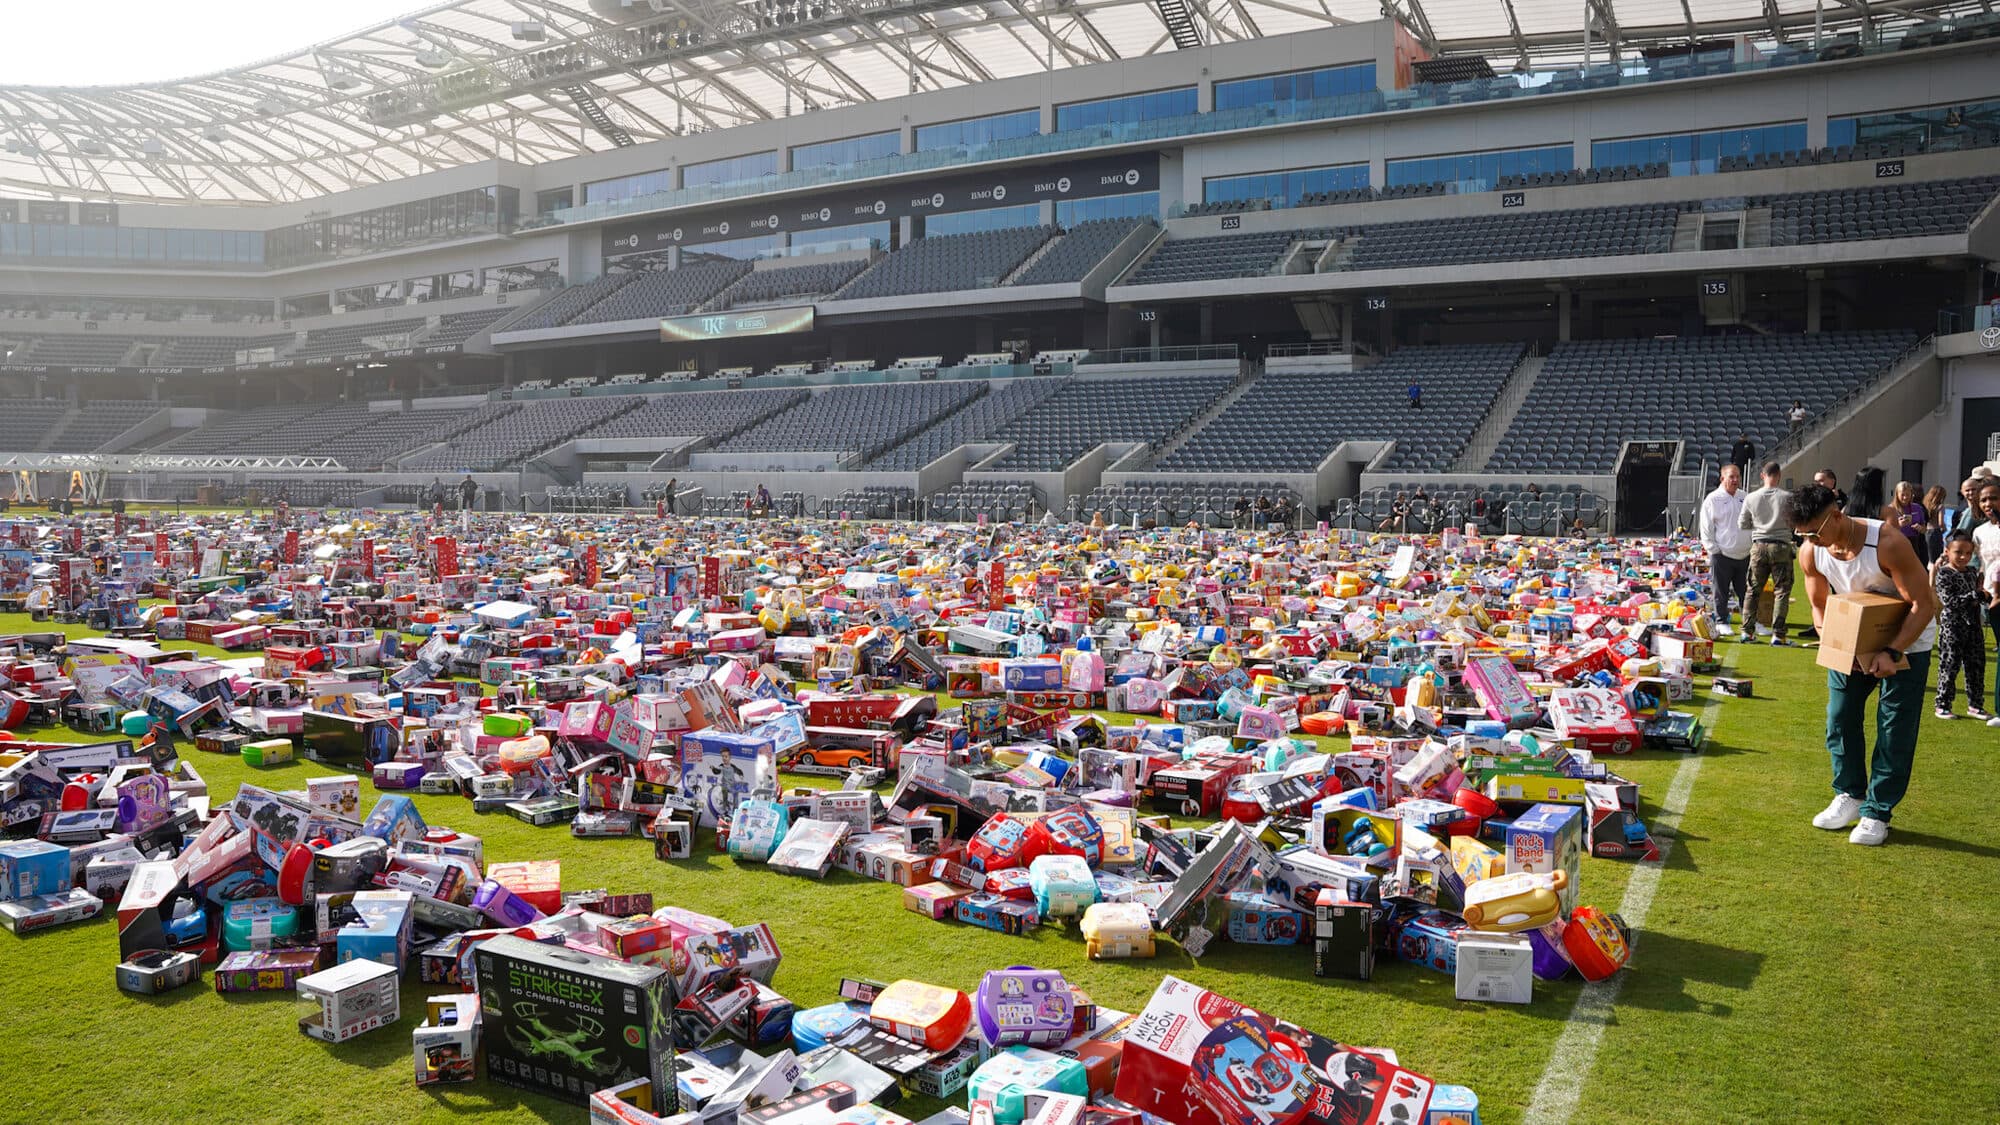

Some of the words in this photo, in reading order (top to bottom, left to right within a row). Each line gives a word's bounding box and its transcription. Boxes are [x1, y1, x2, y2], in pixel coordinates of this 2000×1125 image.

[1879, 164, 1902, 176] 235
[1100, 175, 1123, 185] BMO
[1034, 182, 1055, 193] BMO
[970, 190, 991, 201] BMO
[911, 198, 930, 208] BMO
[1504, 196, 1523, 207] 234
[854, 205, 873, 215] BMO
[801, 212, 818, 222] BMO
[750, 219, 767, 228] BMO
[1223, 219, 1239, 229] 233
[702, 225, 718, 235] BMO
[657, 232, 672, 241] BMO
[614, 239, 629, 247] BMO
[1704, 283, 1726, 295] 135
[1367, 299, 1386, 310] 134
[1139, 311, 1156, 321] 133
[833, 706, 873, 714] MIKE
[823, 715, 883, 724] TYSON
[1514, 833, 1544, 847] Kid's
[1516, 847, 1544, 858] Band
[538, 968, 549, 977] IN
[552, 972, 572, 982] THE
[575, 977, 604, 989] DARK
[510, 970, 604, 1007] STRIKER-X
[510, 988, 523, 996] HD
[525, 990, 566, 1006] CAMERA
[569, 1001, 605, 1016] DRONE
[1135, 1013, 1158, 1040] MIKE
[1147, 1011, 1176, 1044] TYSON
